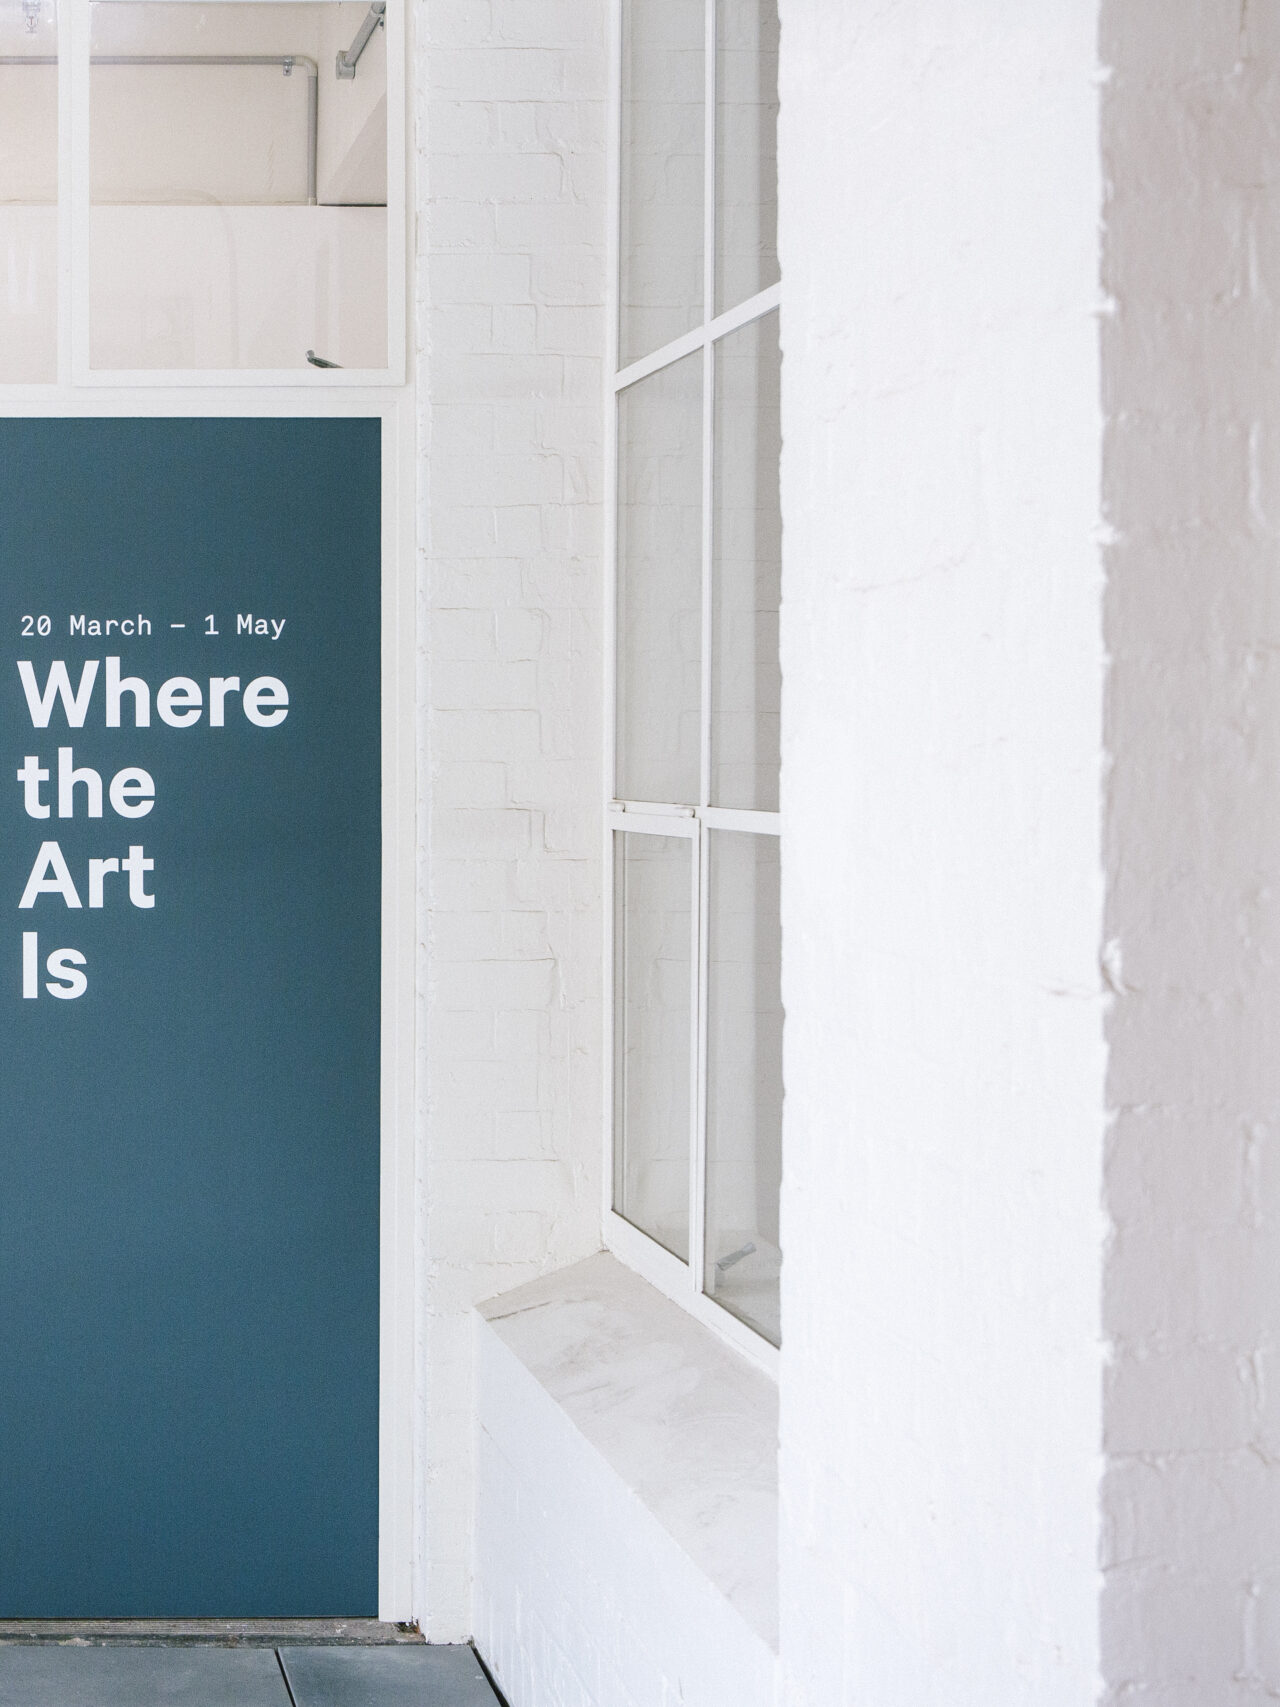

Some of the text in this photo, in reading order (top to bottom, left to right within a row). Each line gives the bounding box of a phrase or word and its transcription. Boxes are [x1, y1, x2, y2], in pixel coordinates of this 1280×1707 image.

[21, 615, 51, 636] 20
[70, 614, 151, 636] March
[205, 615, 219, 634] 1
[237, 614, 285, 640] May
[17, 656, 289, 728] Where
[17, 747, 155, 819] the
[18, 841, 155, 909] Art
[23, 932, 87, 999] Is
